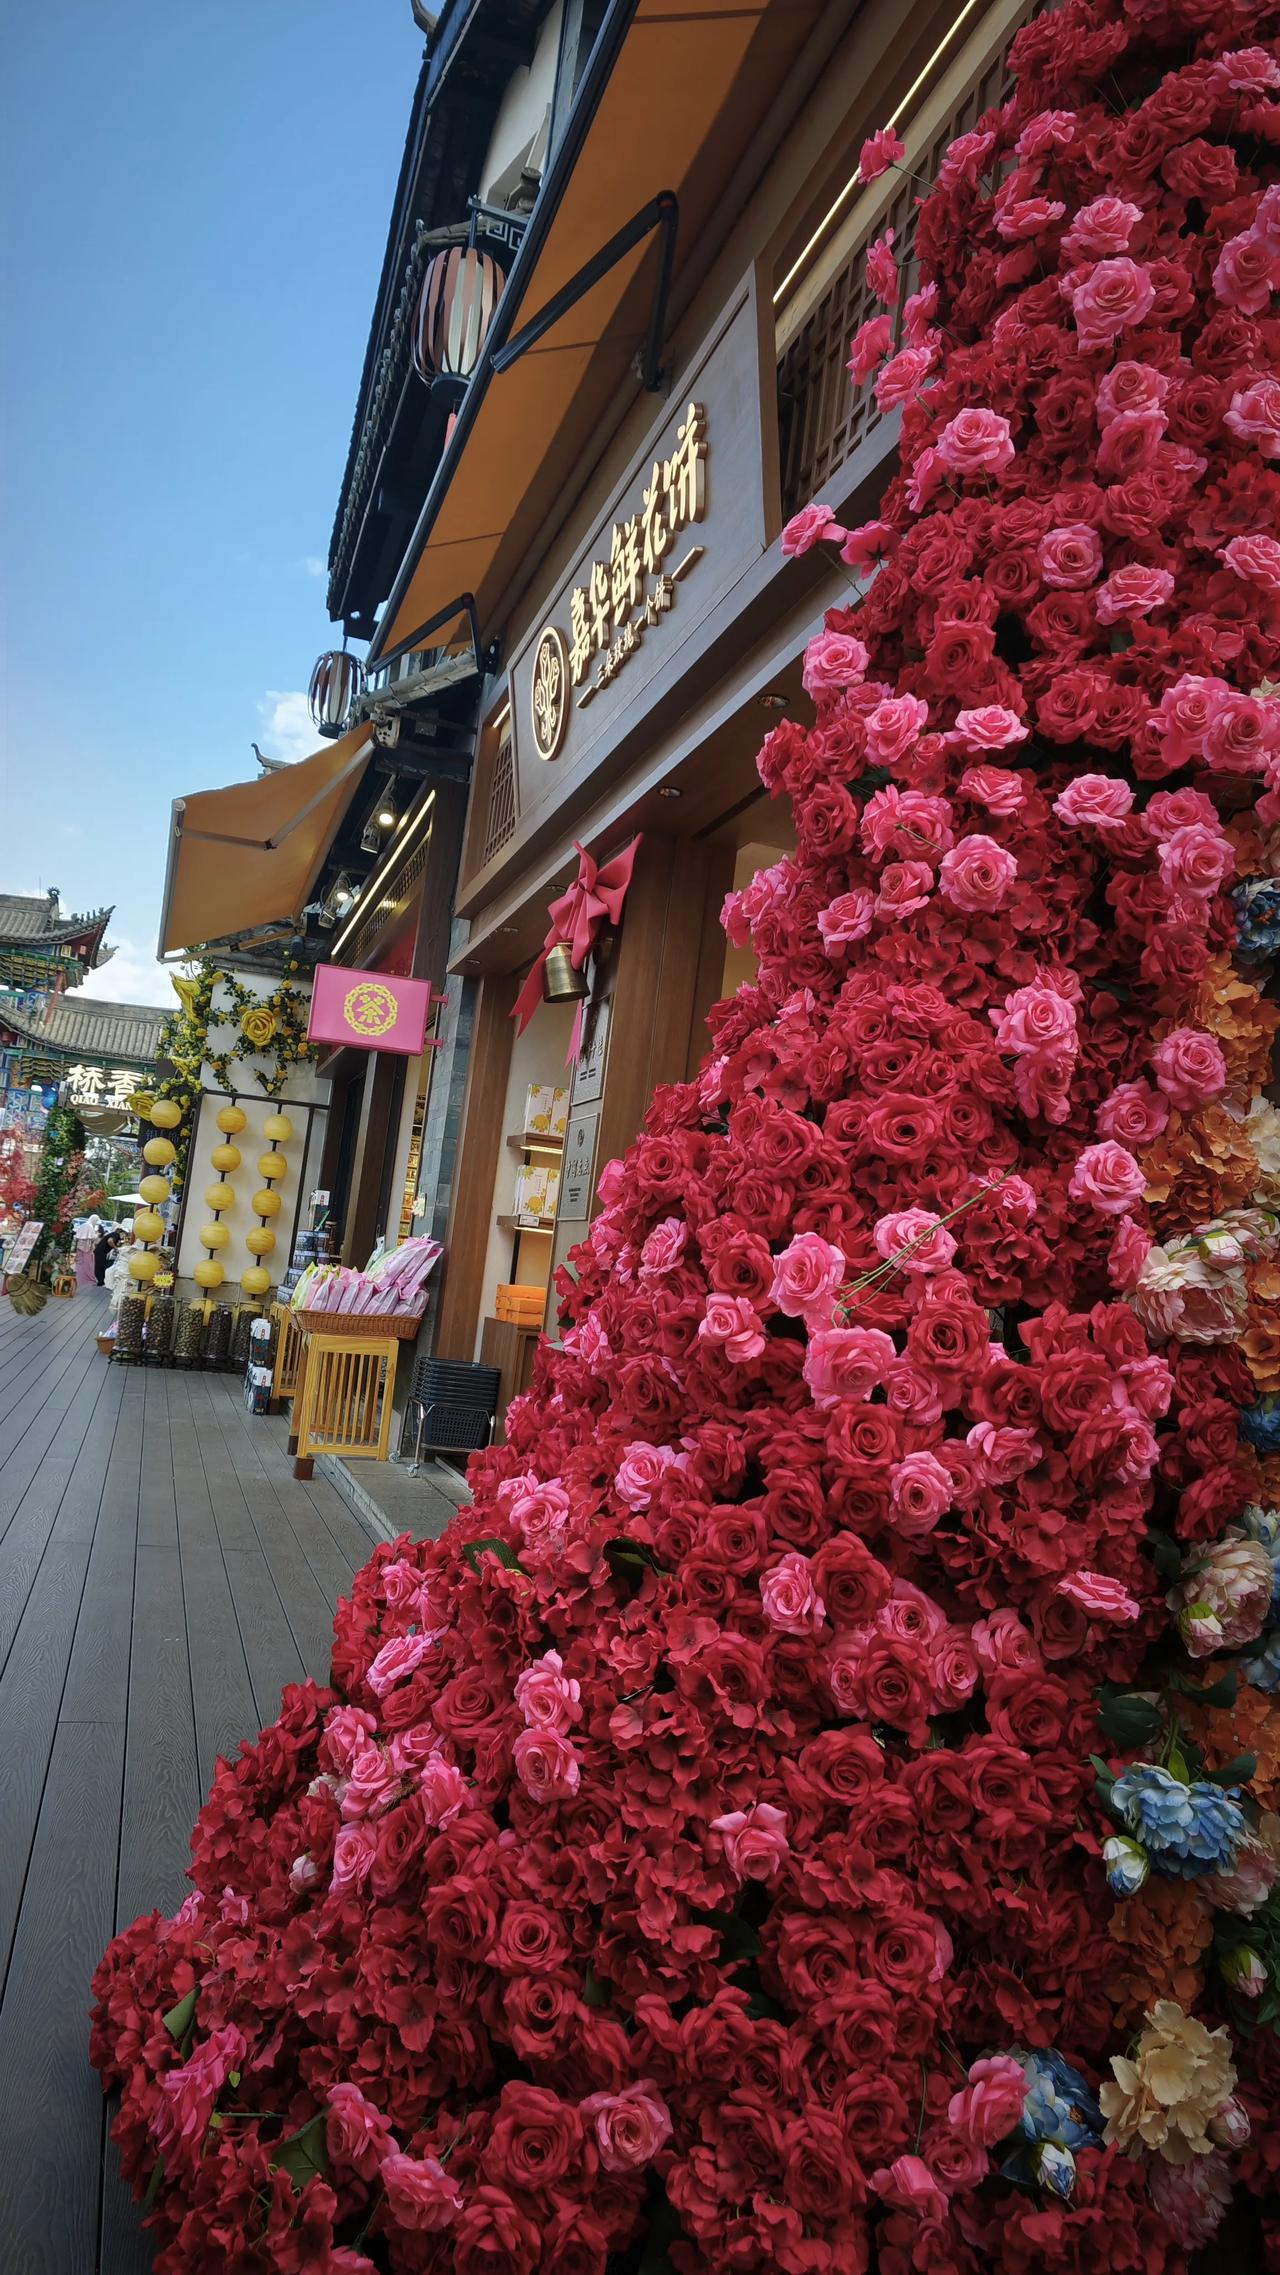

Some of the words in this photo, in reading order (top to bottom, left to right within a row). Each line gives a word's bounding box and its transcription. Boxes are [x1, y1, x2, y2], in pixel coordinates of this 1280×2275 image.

[568, 402, 705, 688] 嘉华鲜花饼
[66, 1063, 156, 1098] 桥香
[69, 1094, 98, 1106] QIAO
